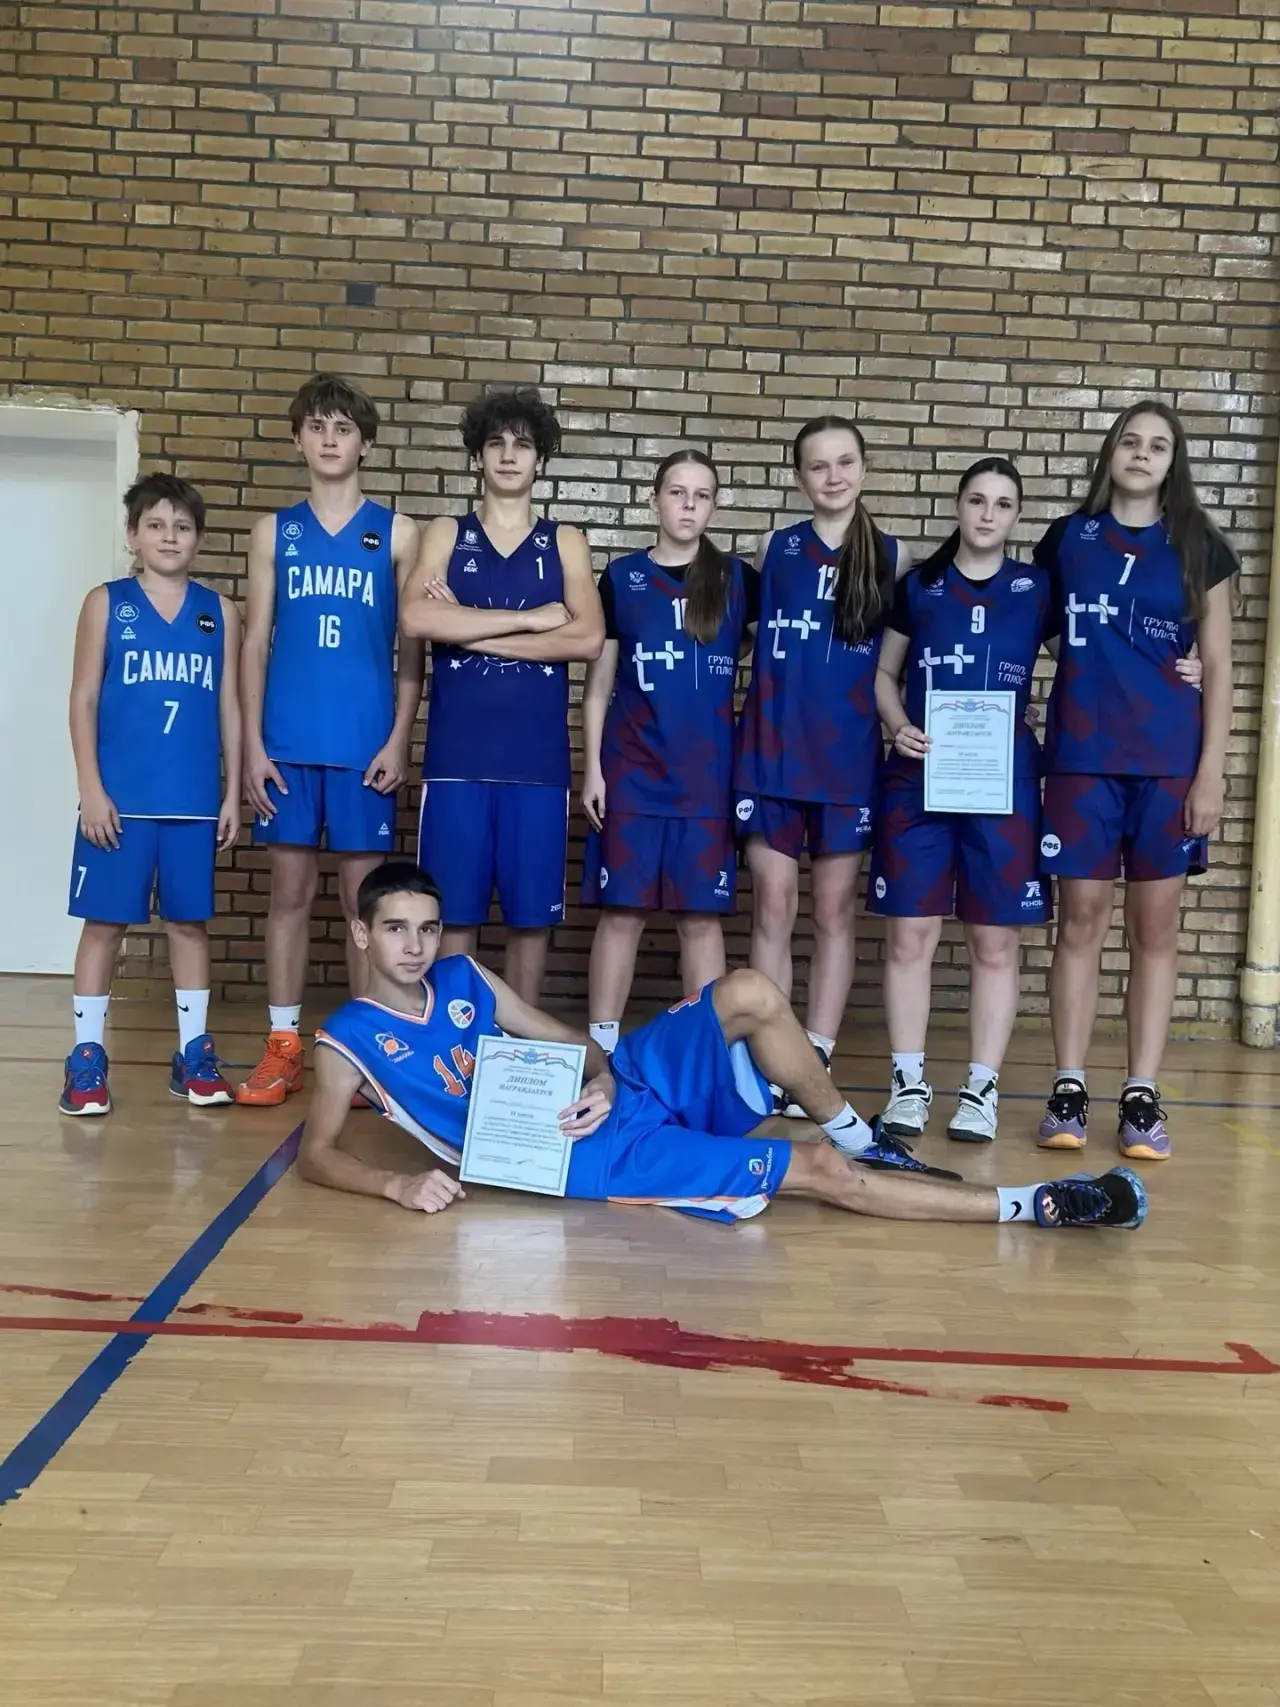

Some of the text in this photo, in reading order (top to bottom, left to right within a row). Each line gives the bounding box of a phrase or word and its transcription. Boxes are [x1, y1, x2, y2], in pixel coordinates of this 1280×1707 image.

[535, 556, 544, 580] 1
[816, 564, 839, 601] 12
[1118, 552, 1136, 585] 7
[288, 565, 375, 607] САМАРА
[318, 614, 341, 648] 16
[970, 605, 986, 634] 9
[123, 650, 213, 691] САМАРА
[162, 700, 180, 734] 7
[1042, 841, 1059, 850] РФБ
[75, 865, 88, 898] 7
[506, 1074, 548, 1087] ДИПЛОМ
